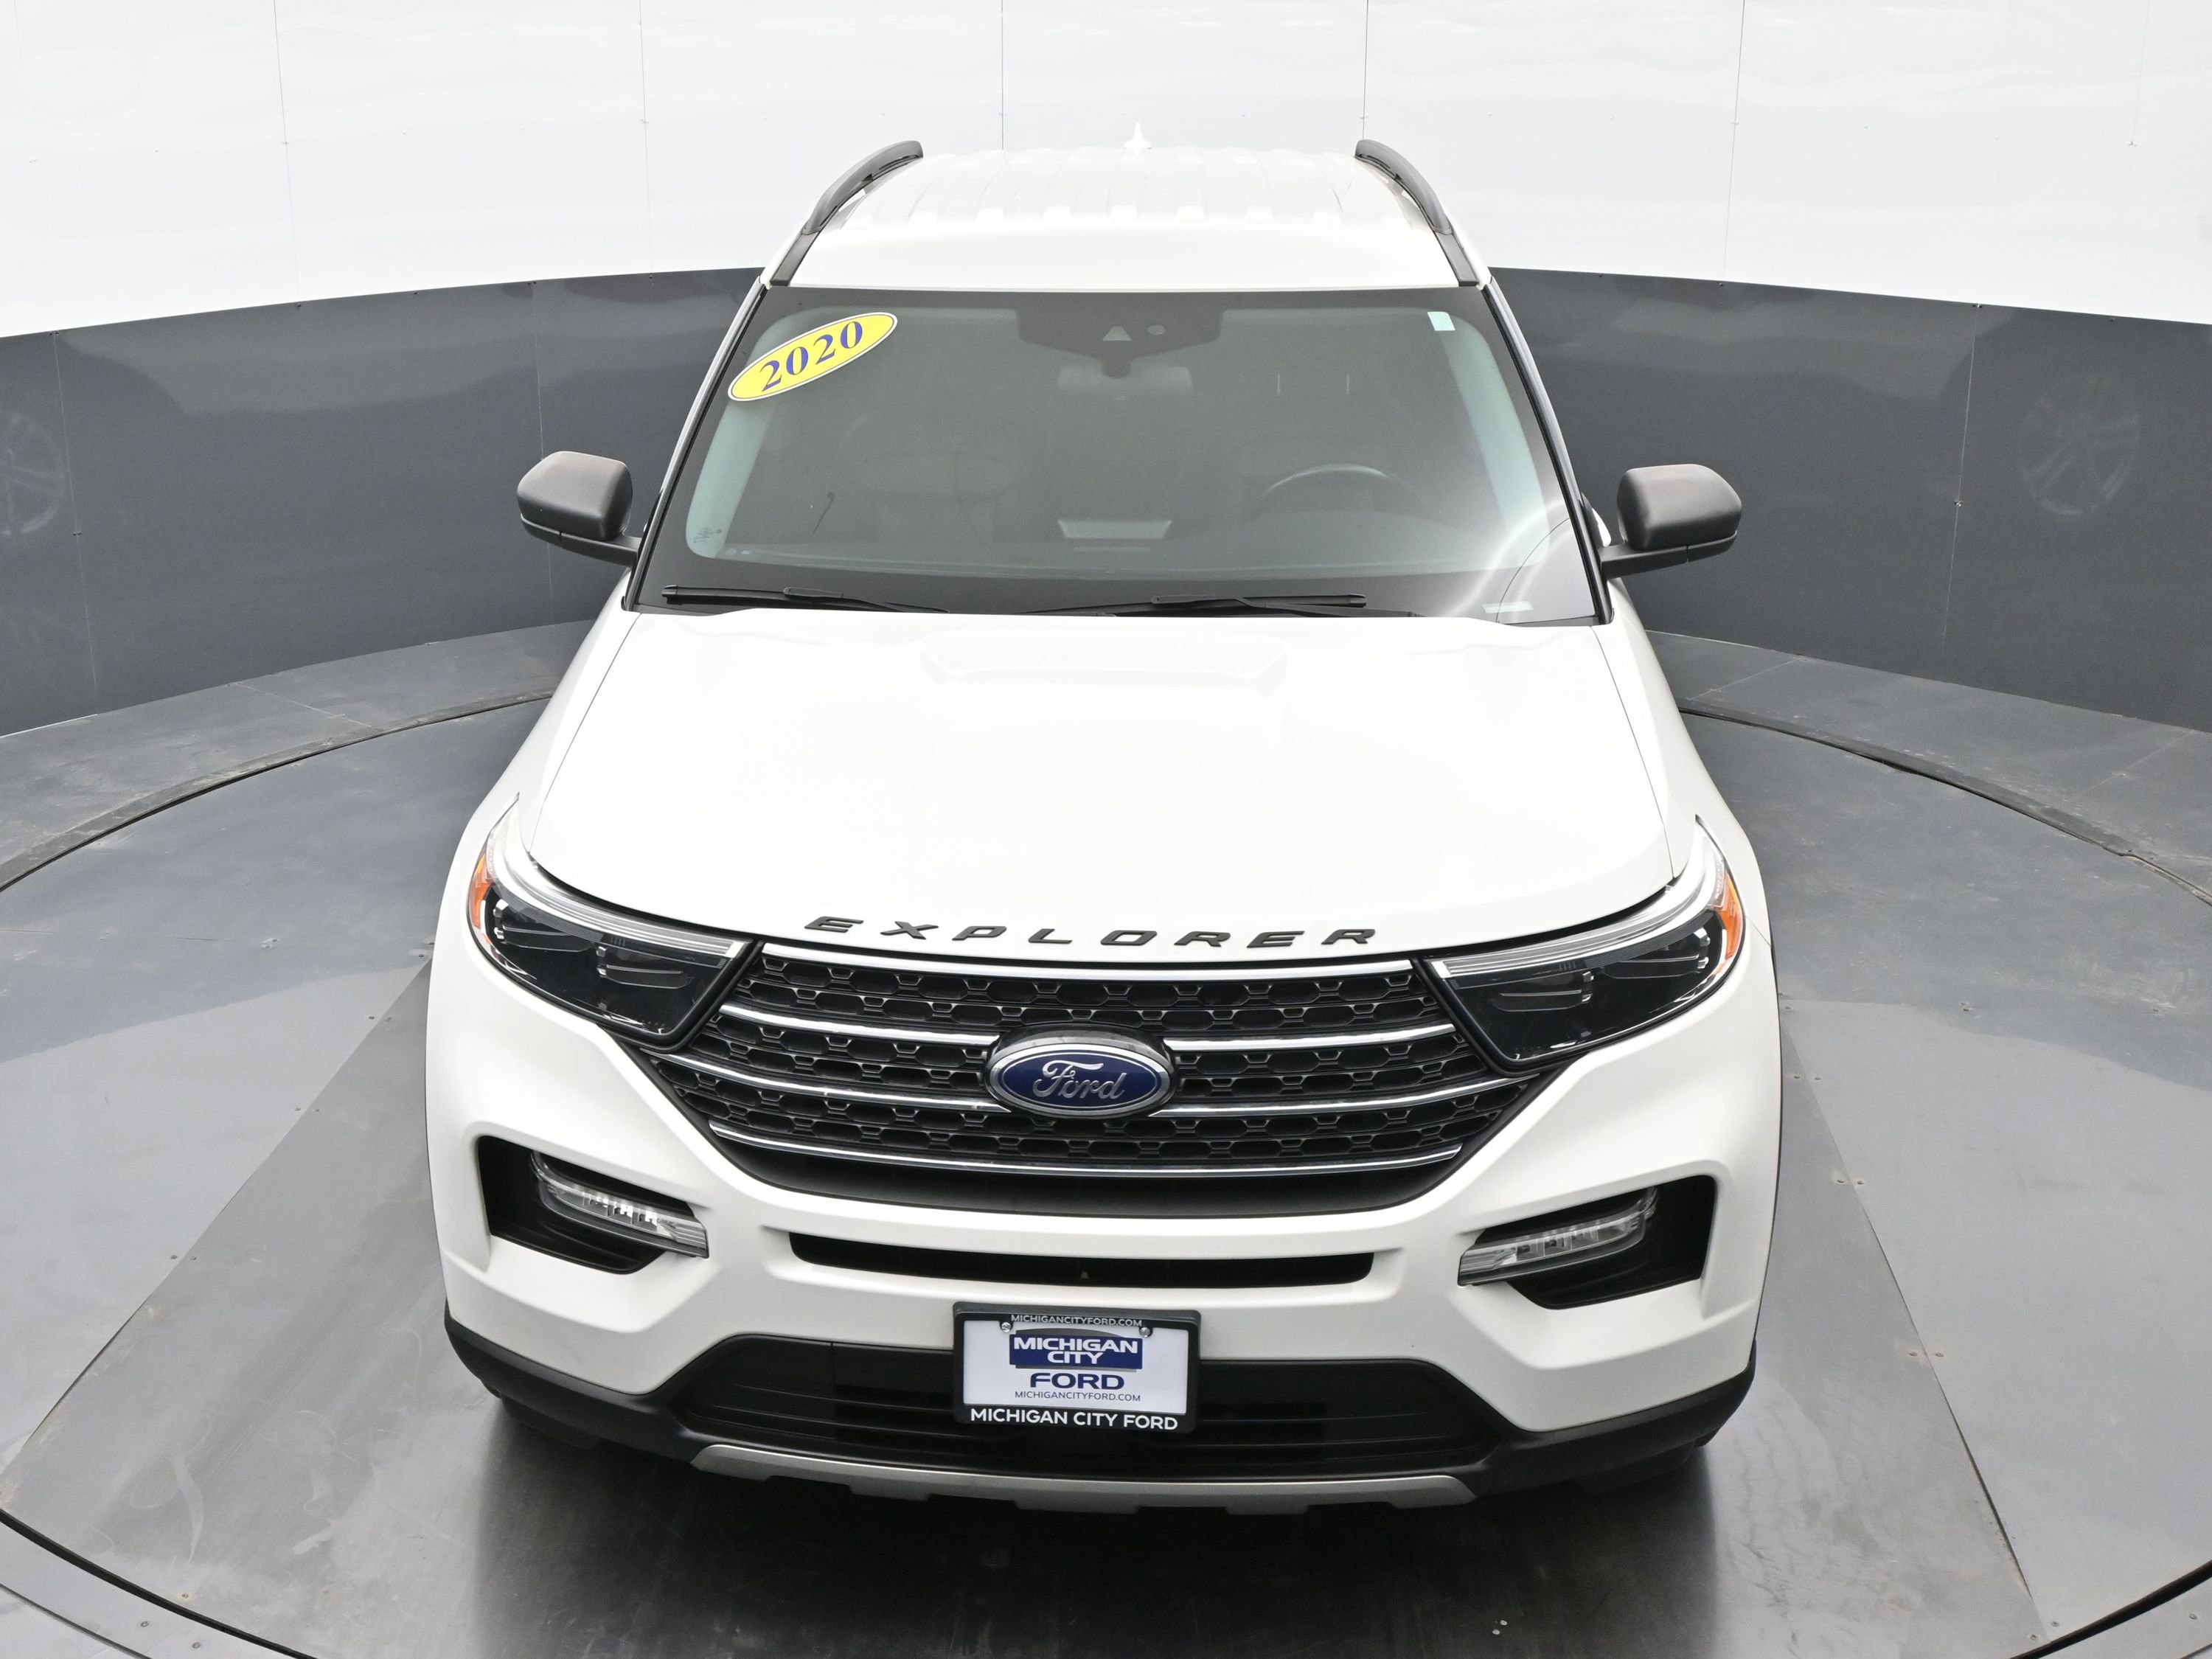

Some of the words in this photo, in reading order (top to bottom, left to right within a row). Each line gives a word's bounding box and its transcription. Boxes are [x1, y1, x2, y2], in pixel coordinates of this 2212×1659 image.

[759, 321, 863, 392] 2020
[804, 917, 1376, 948] EXPLORER
[1032, 1060, 1127, 1099] Ford
[1011, 1314, 1142, 1327] MICHIGANCITYFORD.COM
[1014, 1338, 1138, 1354] MICHIGAN
[1047, 1351, 1104, 1364] CITY
[1030, 1372, 1124, 1390] FORD
[1015, 1391, 1141, 1402] MICHIGANCITYFORD.COM
[970, 1408, 1068, 1425] MICHIGAN
[1073, 1411, 1118, 1427] CITY
[1123, 1414, 1178, 1430] FORD
